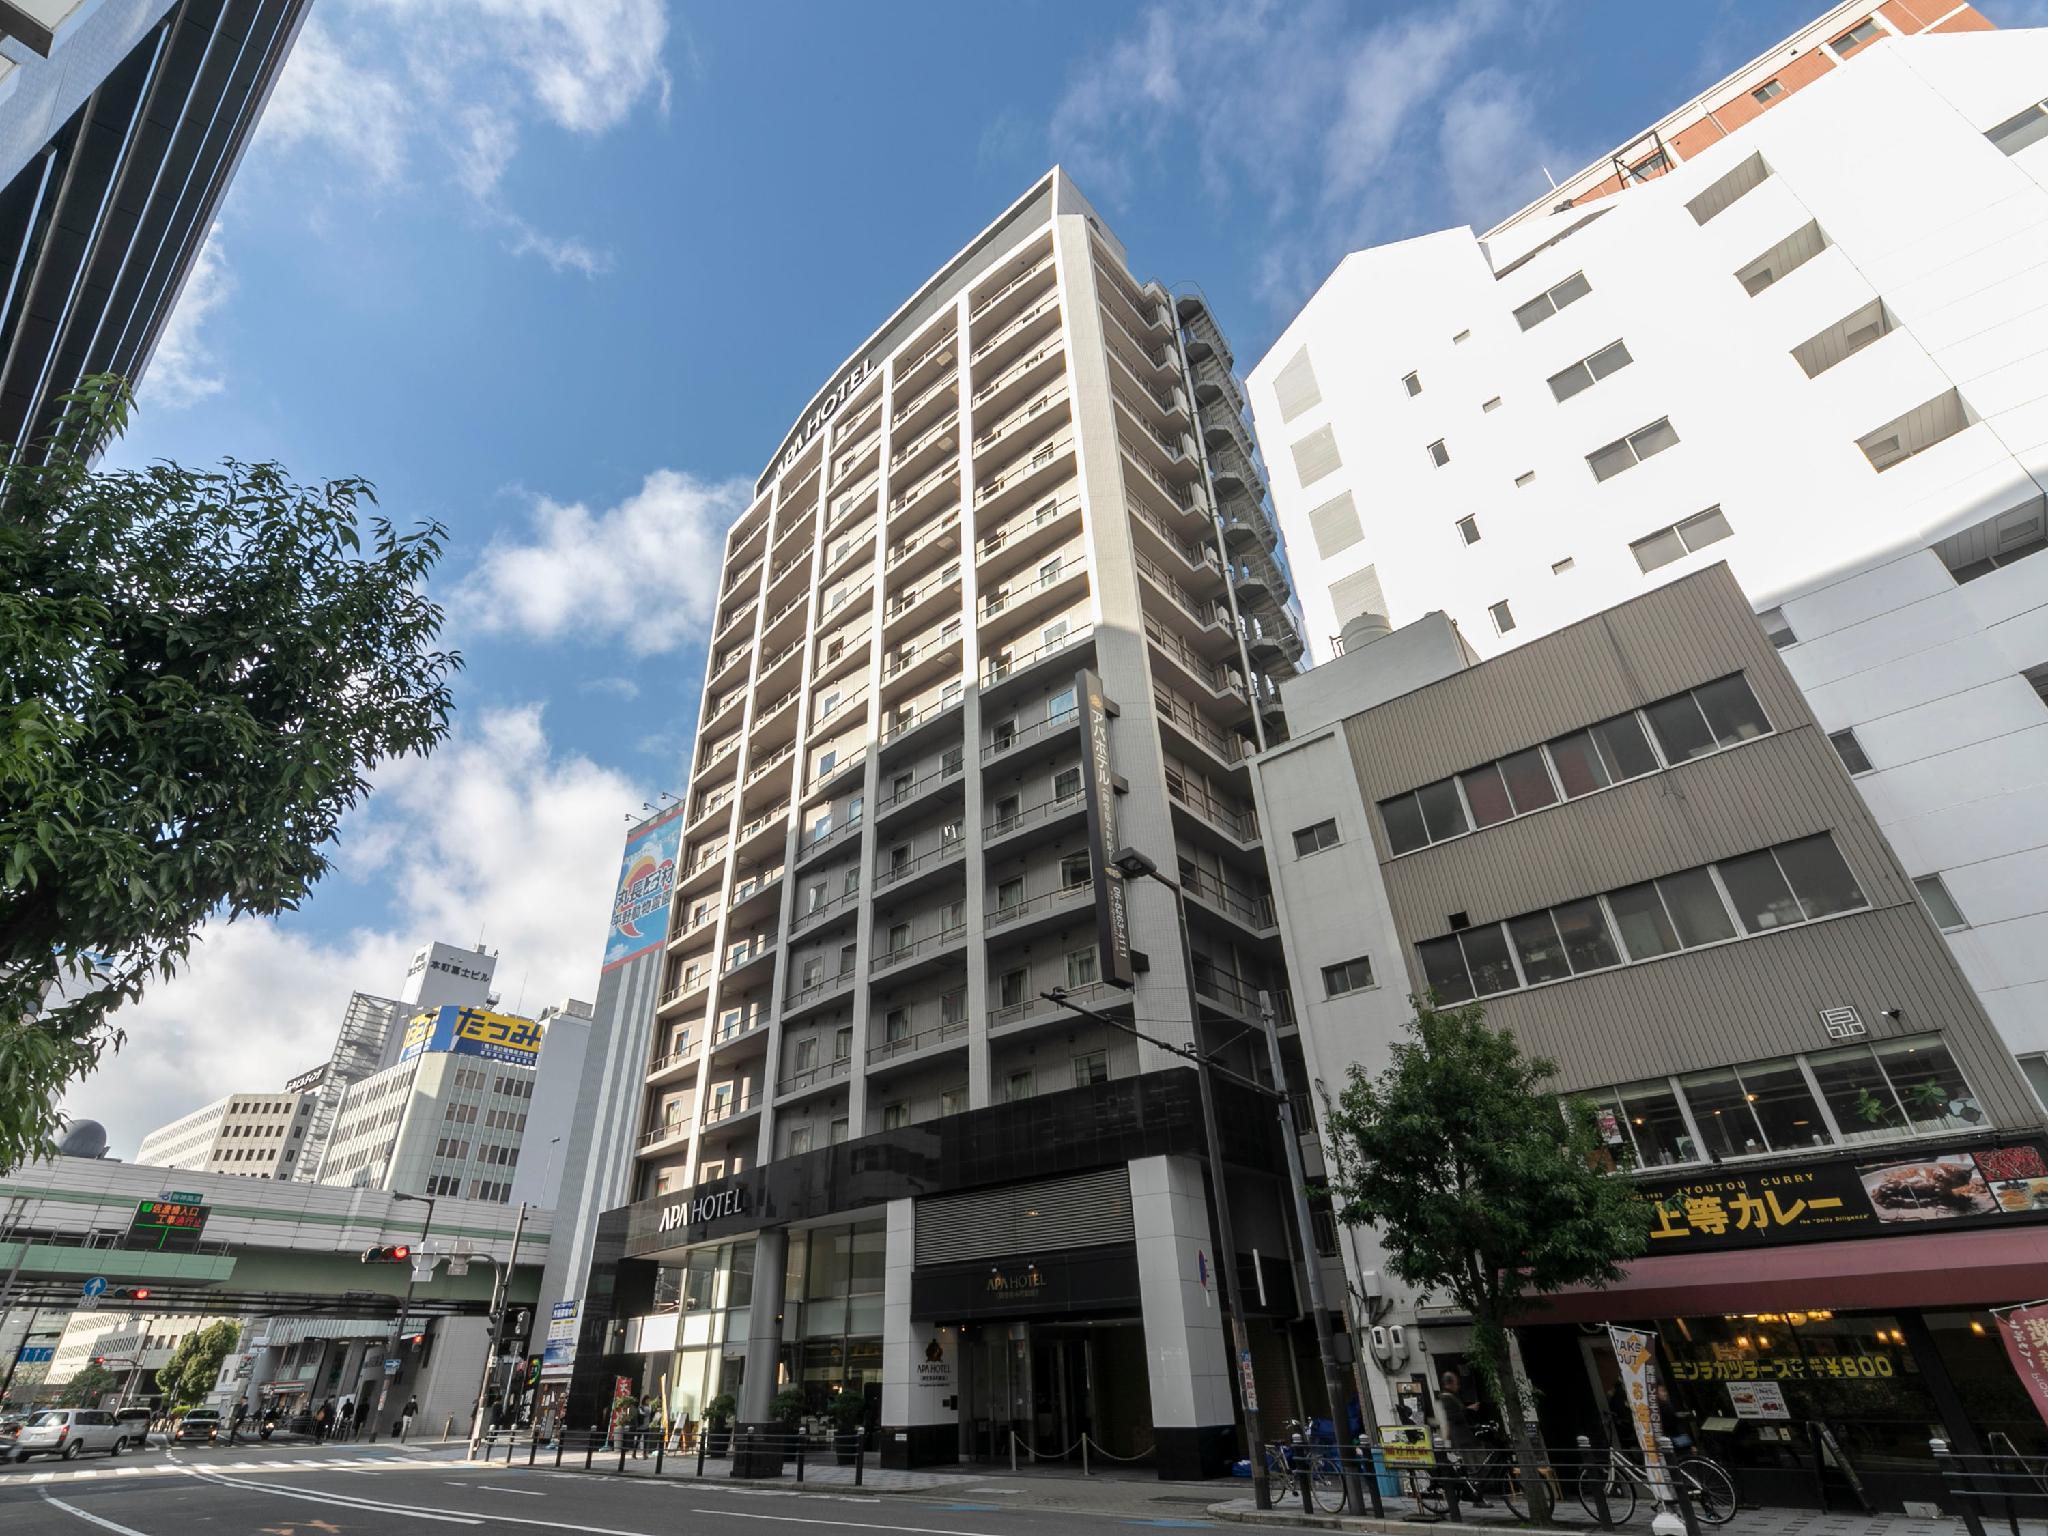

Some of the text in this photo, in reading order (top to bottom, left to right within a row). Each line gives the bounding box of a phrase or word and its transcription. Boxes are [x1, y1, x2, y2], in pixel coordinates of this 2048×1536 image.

[806, 359, 877, 440] HOTEL
[1091, 709, 1110, 785] アパホテル
[430, 960, 490, 982] 本町富士ビル
[455, 1007, 542, 1046] たつみ
[1760, 1173, 1814, 1186] CURRY
[658, 1188, 742, 1233] APA HOTEL
[1650, 1190, 1843, 1239] 上等カレー
[1010, 1272, 1047, 1290] HOTEL
[930, 1363, 952, 1374] HOTEL
